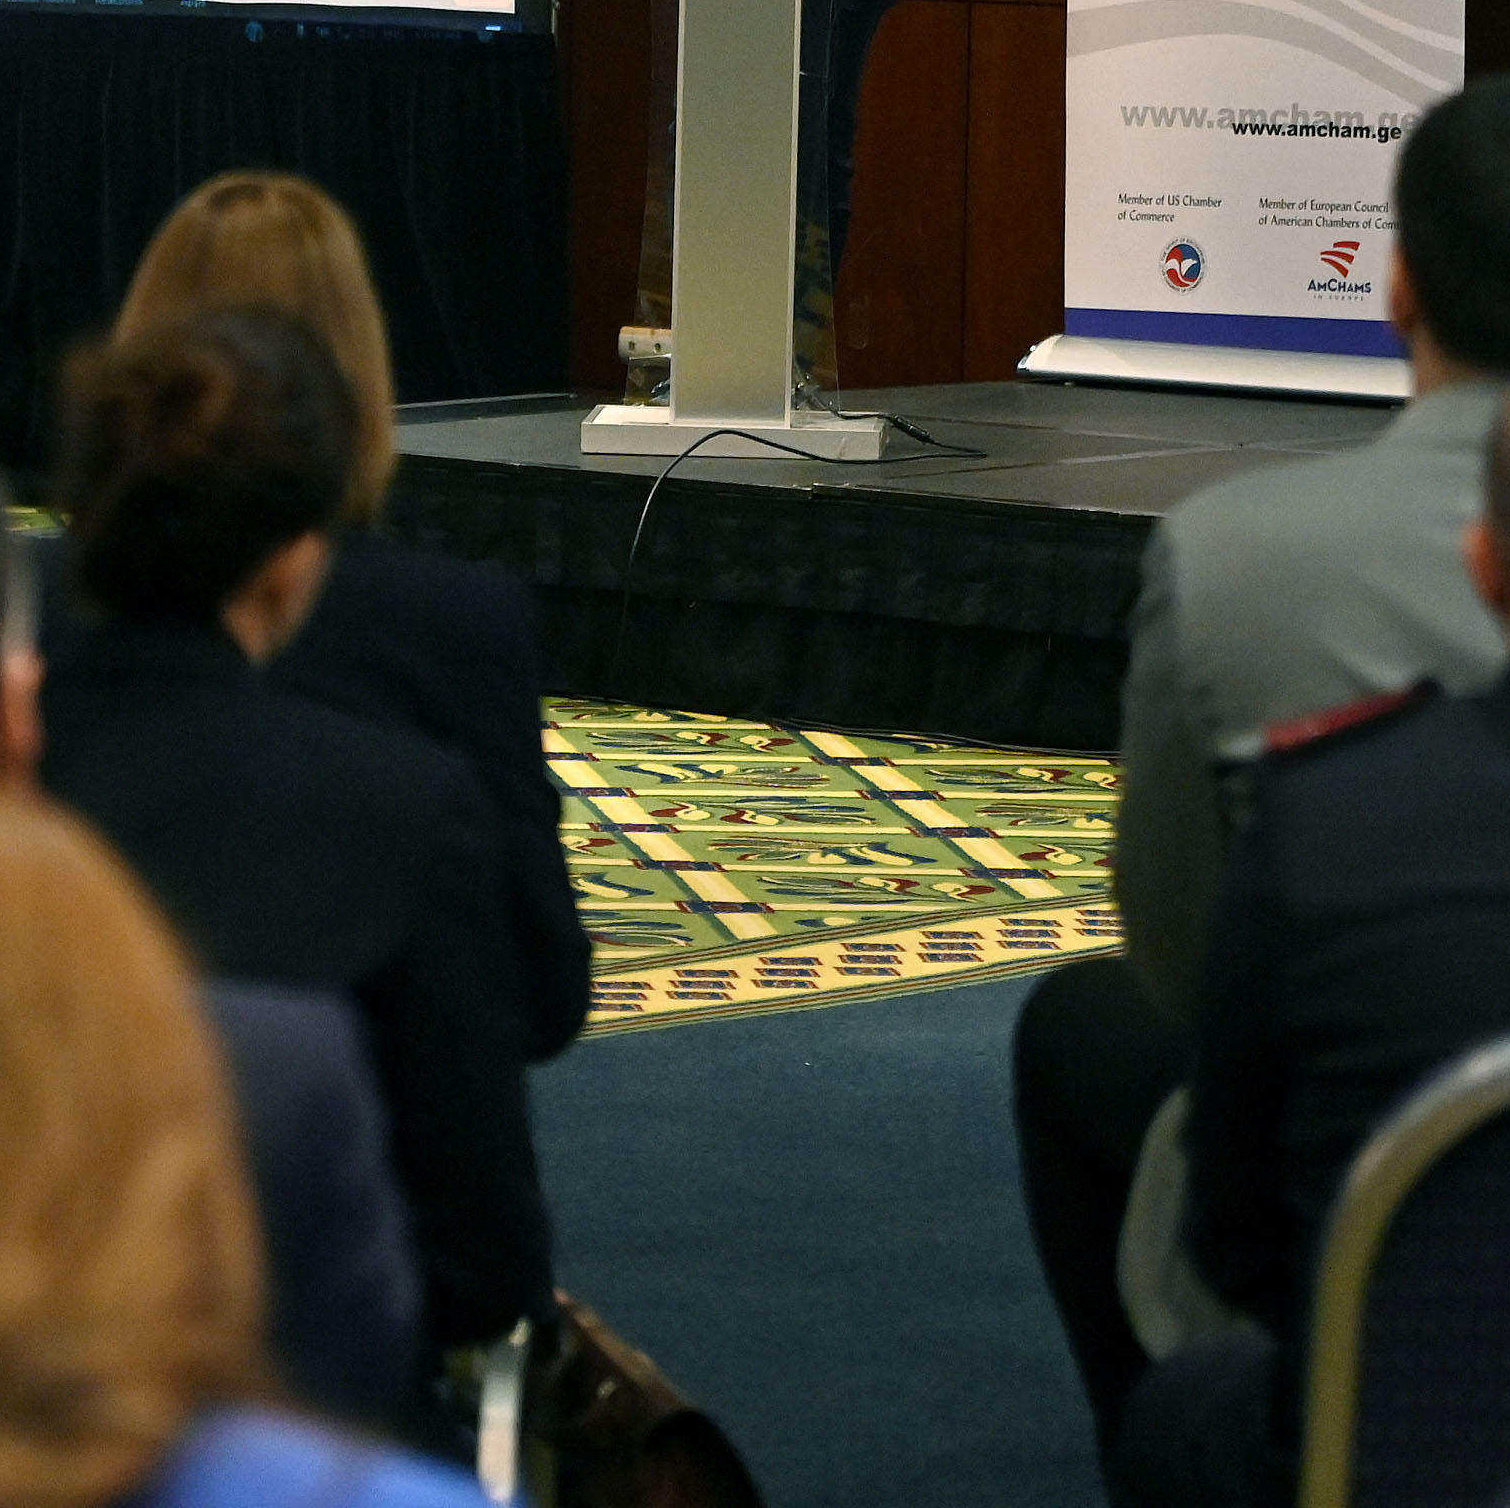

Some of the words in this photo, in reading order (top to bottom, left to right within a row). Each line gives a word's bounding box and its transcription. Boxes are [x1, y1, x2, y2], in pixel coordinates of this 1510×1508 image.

[1231, 120, 1402, 144] www.amcham.ge
[1117, 193, 1153, 206] Member
[1155, 194, 1165, 206] of
[1167, 194, 1180, 207] US
[1182, 195, 1223, 208] Chamber
[1258, 197, 1296, 210] Member
[1298, 199, 1307, 211] of
[1310, 199, 1352, 214] European
[1354, 200, 1389, 213] Council
[1117, 210, 1127, 221] of
[1129, 209, 1175, 223] Commerce
[1258, 215, 1268, 226] of
[1270, 215, 1313, 227] American
[1315, 216, 1360, 229] Chambers
[1361, 217, 1372, 229] of
